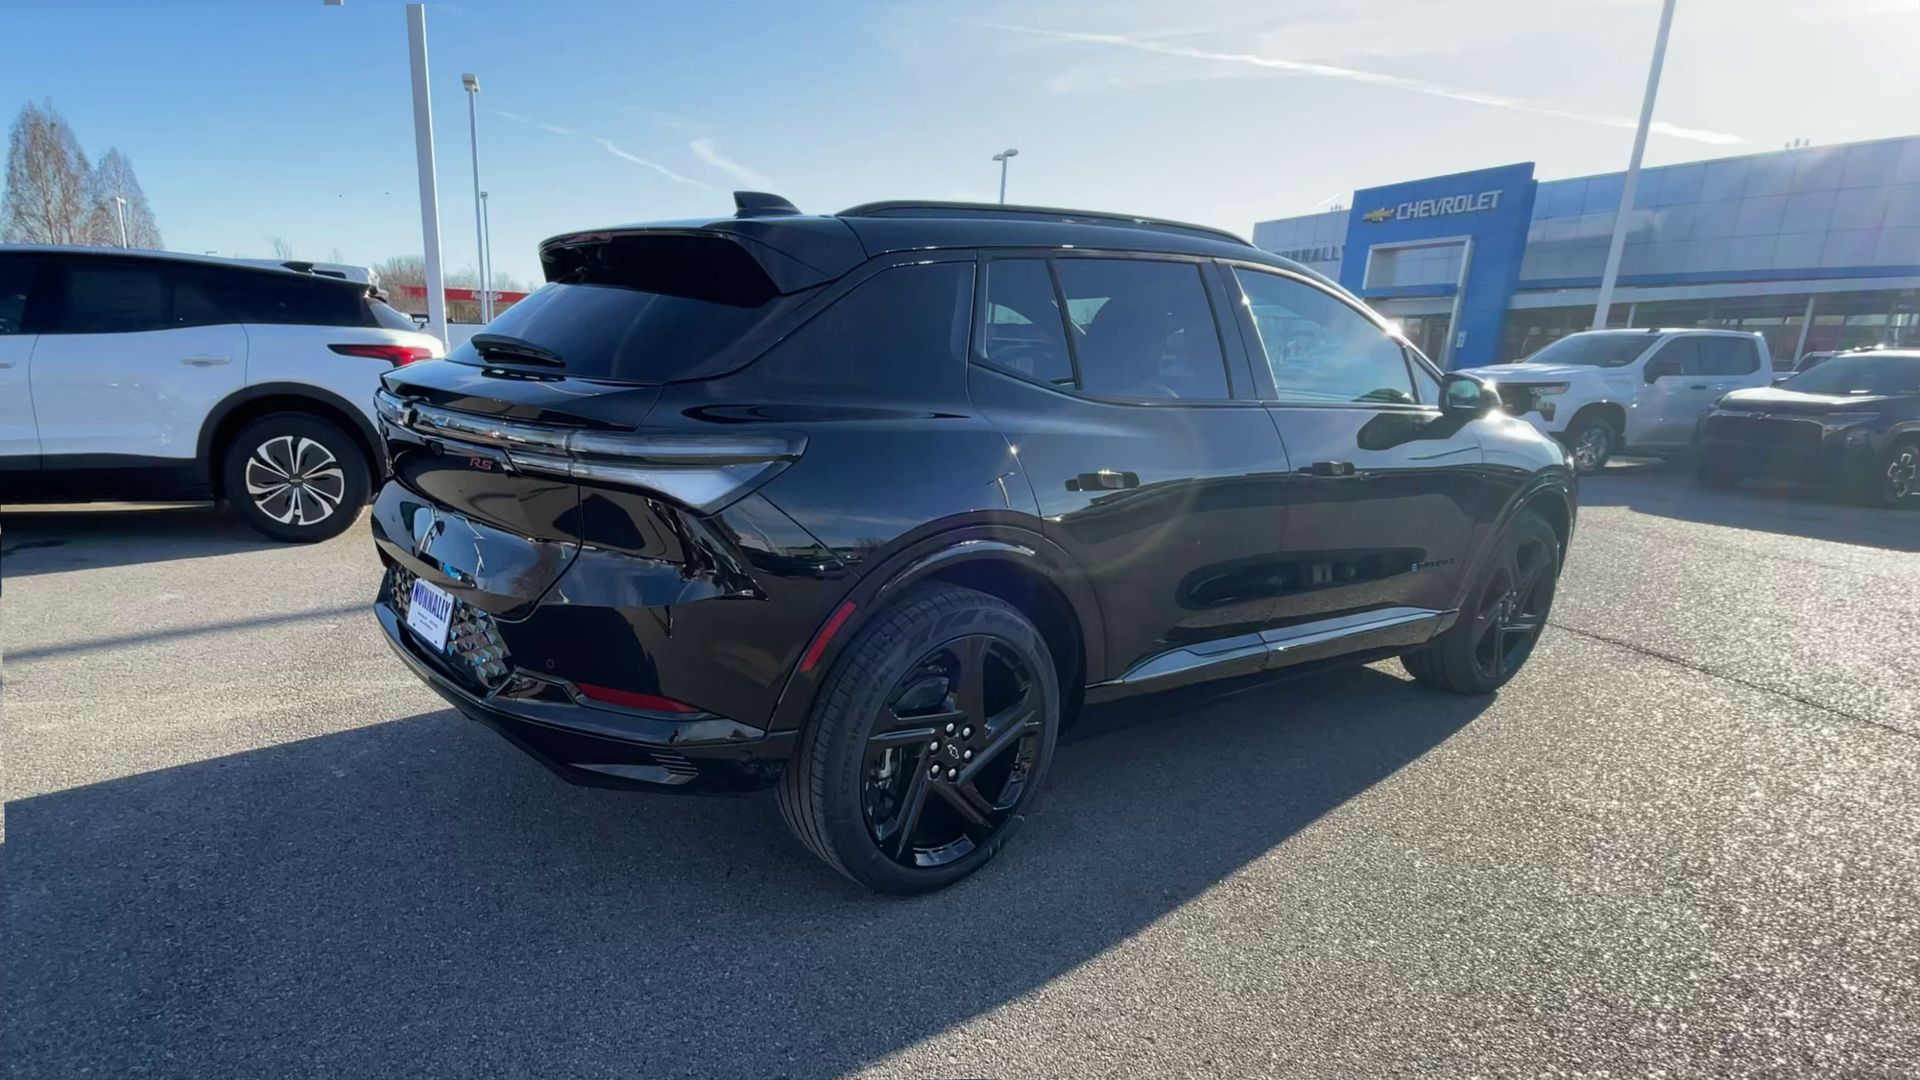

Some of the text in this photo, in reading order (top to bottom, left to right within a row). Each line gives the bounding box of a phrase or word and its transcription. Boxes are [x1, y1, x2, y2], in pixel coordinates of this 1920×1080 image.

[1396, 190, 1503, 220] CHEVROLET
[470, 457, 492, 470] RS
[412, 581, 451, 623] NUNNALLY
